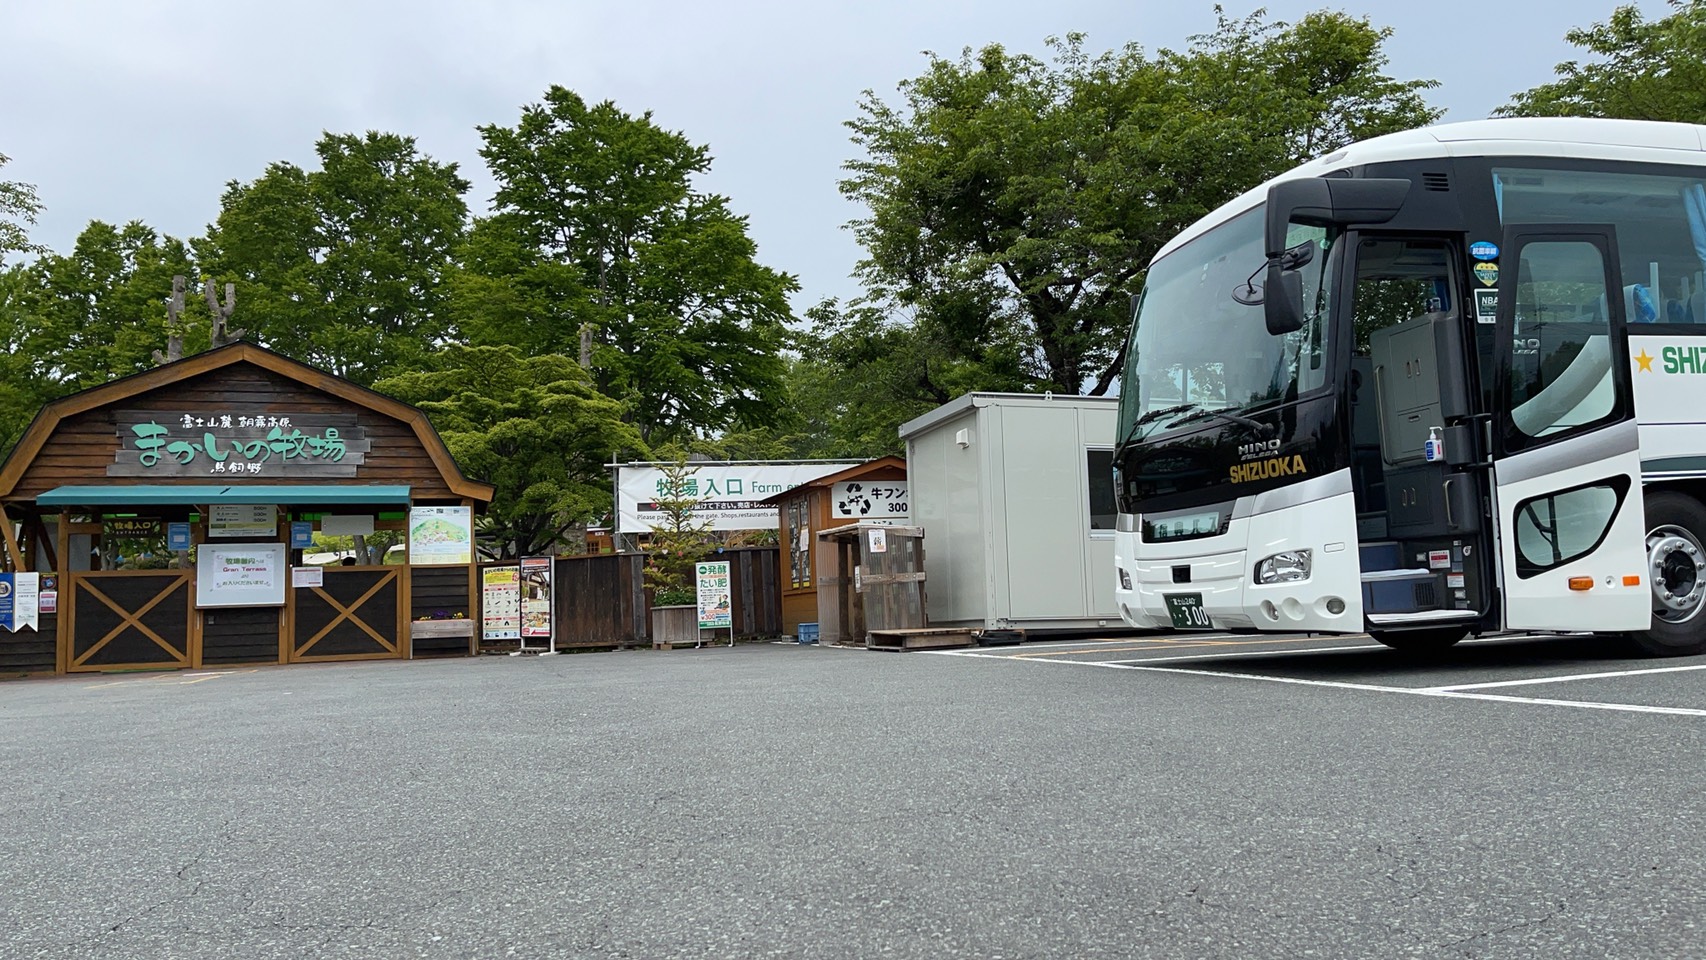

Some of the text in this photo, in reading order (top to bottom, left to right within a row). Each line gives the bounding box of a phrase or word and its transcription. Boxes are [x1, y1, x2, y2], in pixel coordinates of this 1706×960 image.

[179, 414, 292, 429] 富士山麓 朝霧高原
[131, 421, 346, 467] まかいの牧場
[1238, 439, 1281, 455] HINO
[1229, 454, 1307, 484] SHIZUOKA
[656, 478, 743, 497] 牧場入口
[752, 481, 782, 494] Farm
[871, 487, 908, 500] 牛フン
[708, 564, 727, 575] 発酵
[700, 577, 728, 588] たい肥
